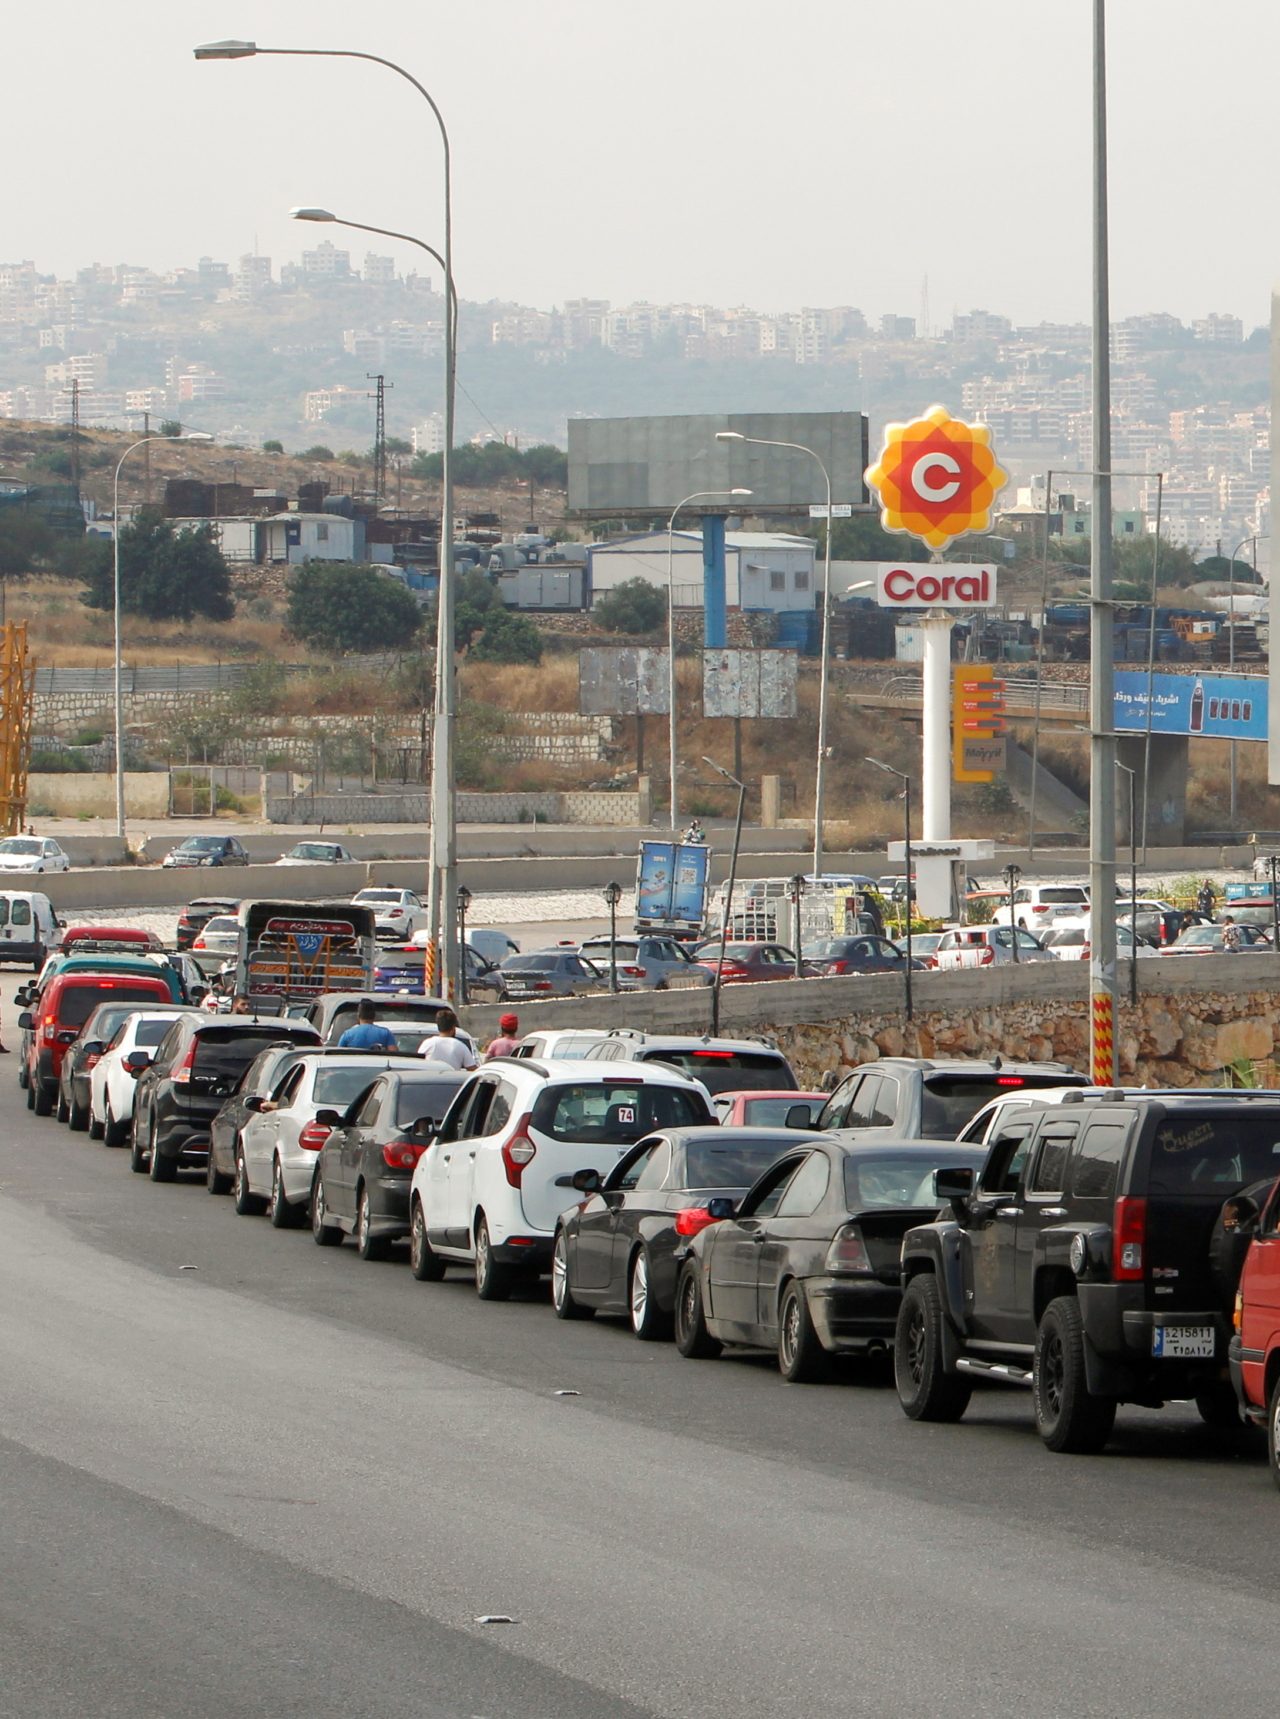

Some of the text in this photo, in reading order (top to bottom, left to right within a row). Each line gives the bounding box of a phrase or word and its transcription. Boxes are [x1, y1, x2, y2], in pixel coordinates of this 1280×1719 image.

[912, 452, 960, 503] C
[883, 569, 989, 601] Coral
[620, 1109, 632, 1121] 74
[1171, 1327, 1211, 1338] 215811
